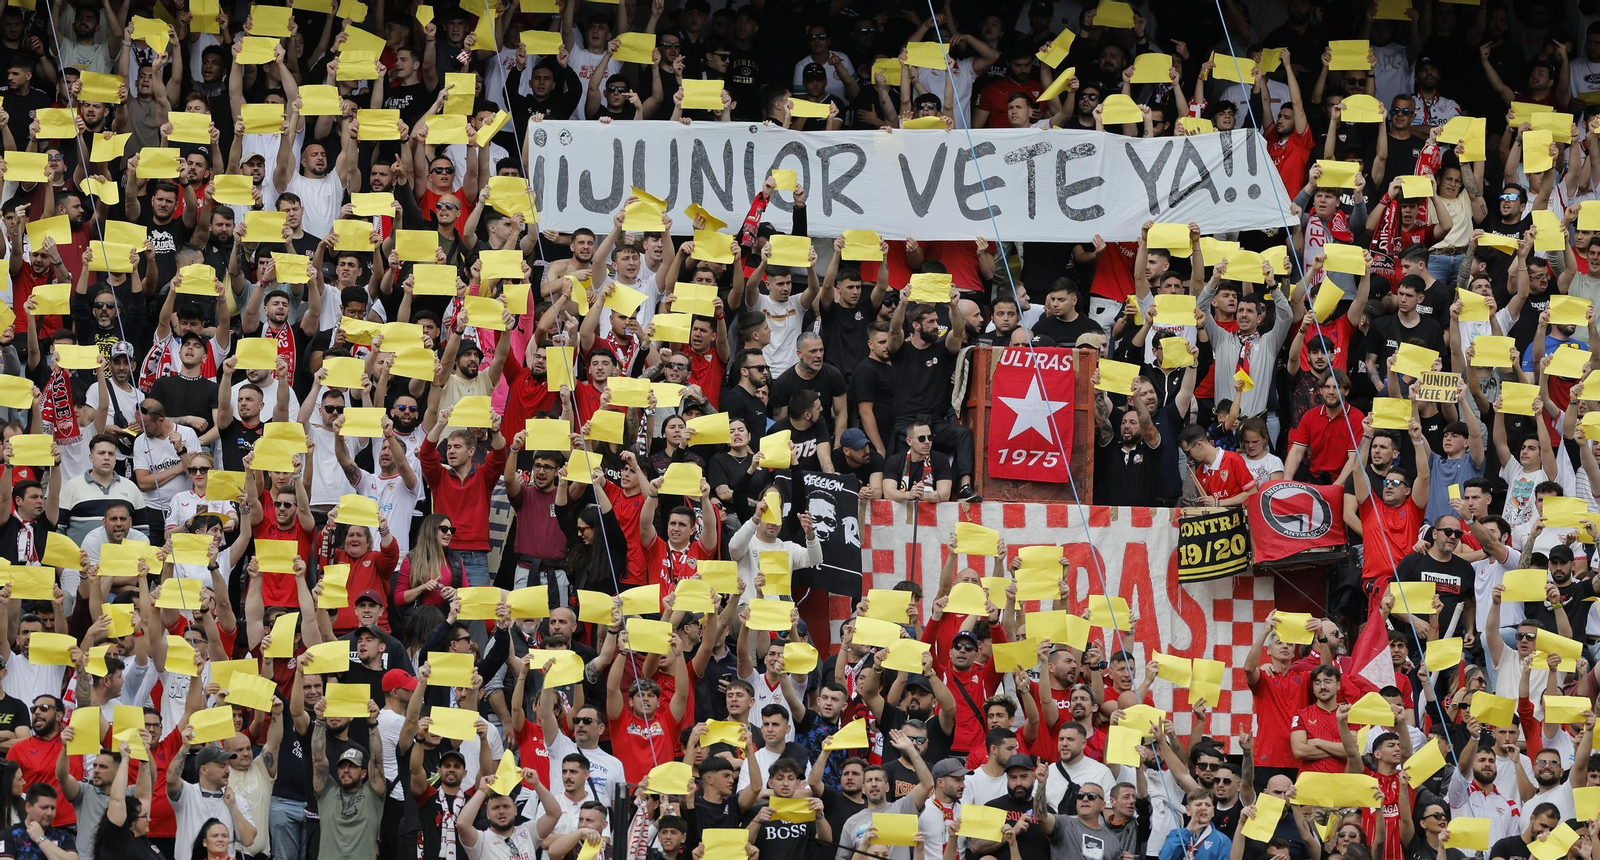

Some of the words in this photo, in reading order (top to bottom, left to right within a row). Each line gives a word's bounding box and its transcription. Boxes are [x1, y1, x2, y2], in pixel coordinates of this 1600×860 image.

[899, 141, 1105, 221] VETE
[1125, 128, 1262, 216] YA!!
[1000, 349, 1073, 371] ULTRAS
[1421, 374, 1459, 387] JUNIOR
[1419, 388, 1441, 400] VETE
[1445, 390, 1457, 401] YA
[998, 448, 1061, 468] 1975
[1283, 523, 1329, 537] ANTIFASCISTA
[1179, 534, 1247, 566] 19/20
[765, 824, 807, 840] BOSS
